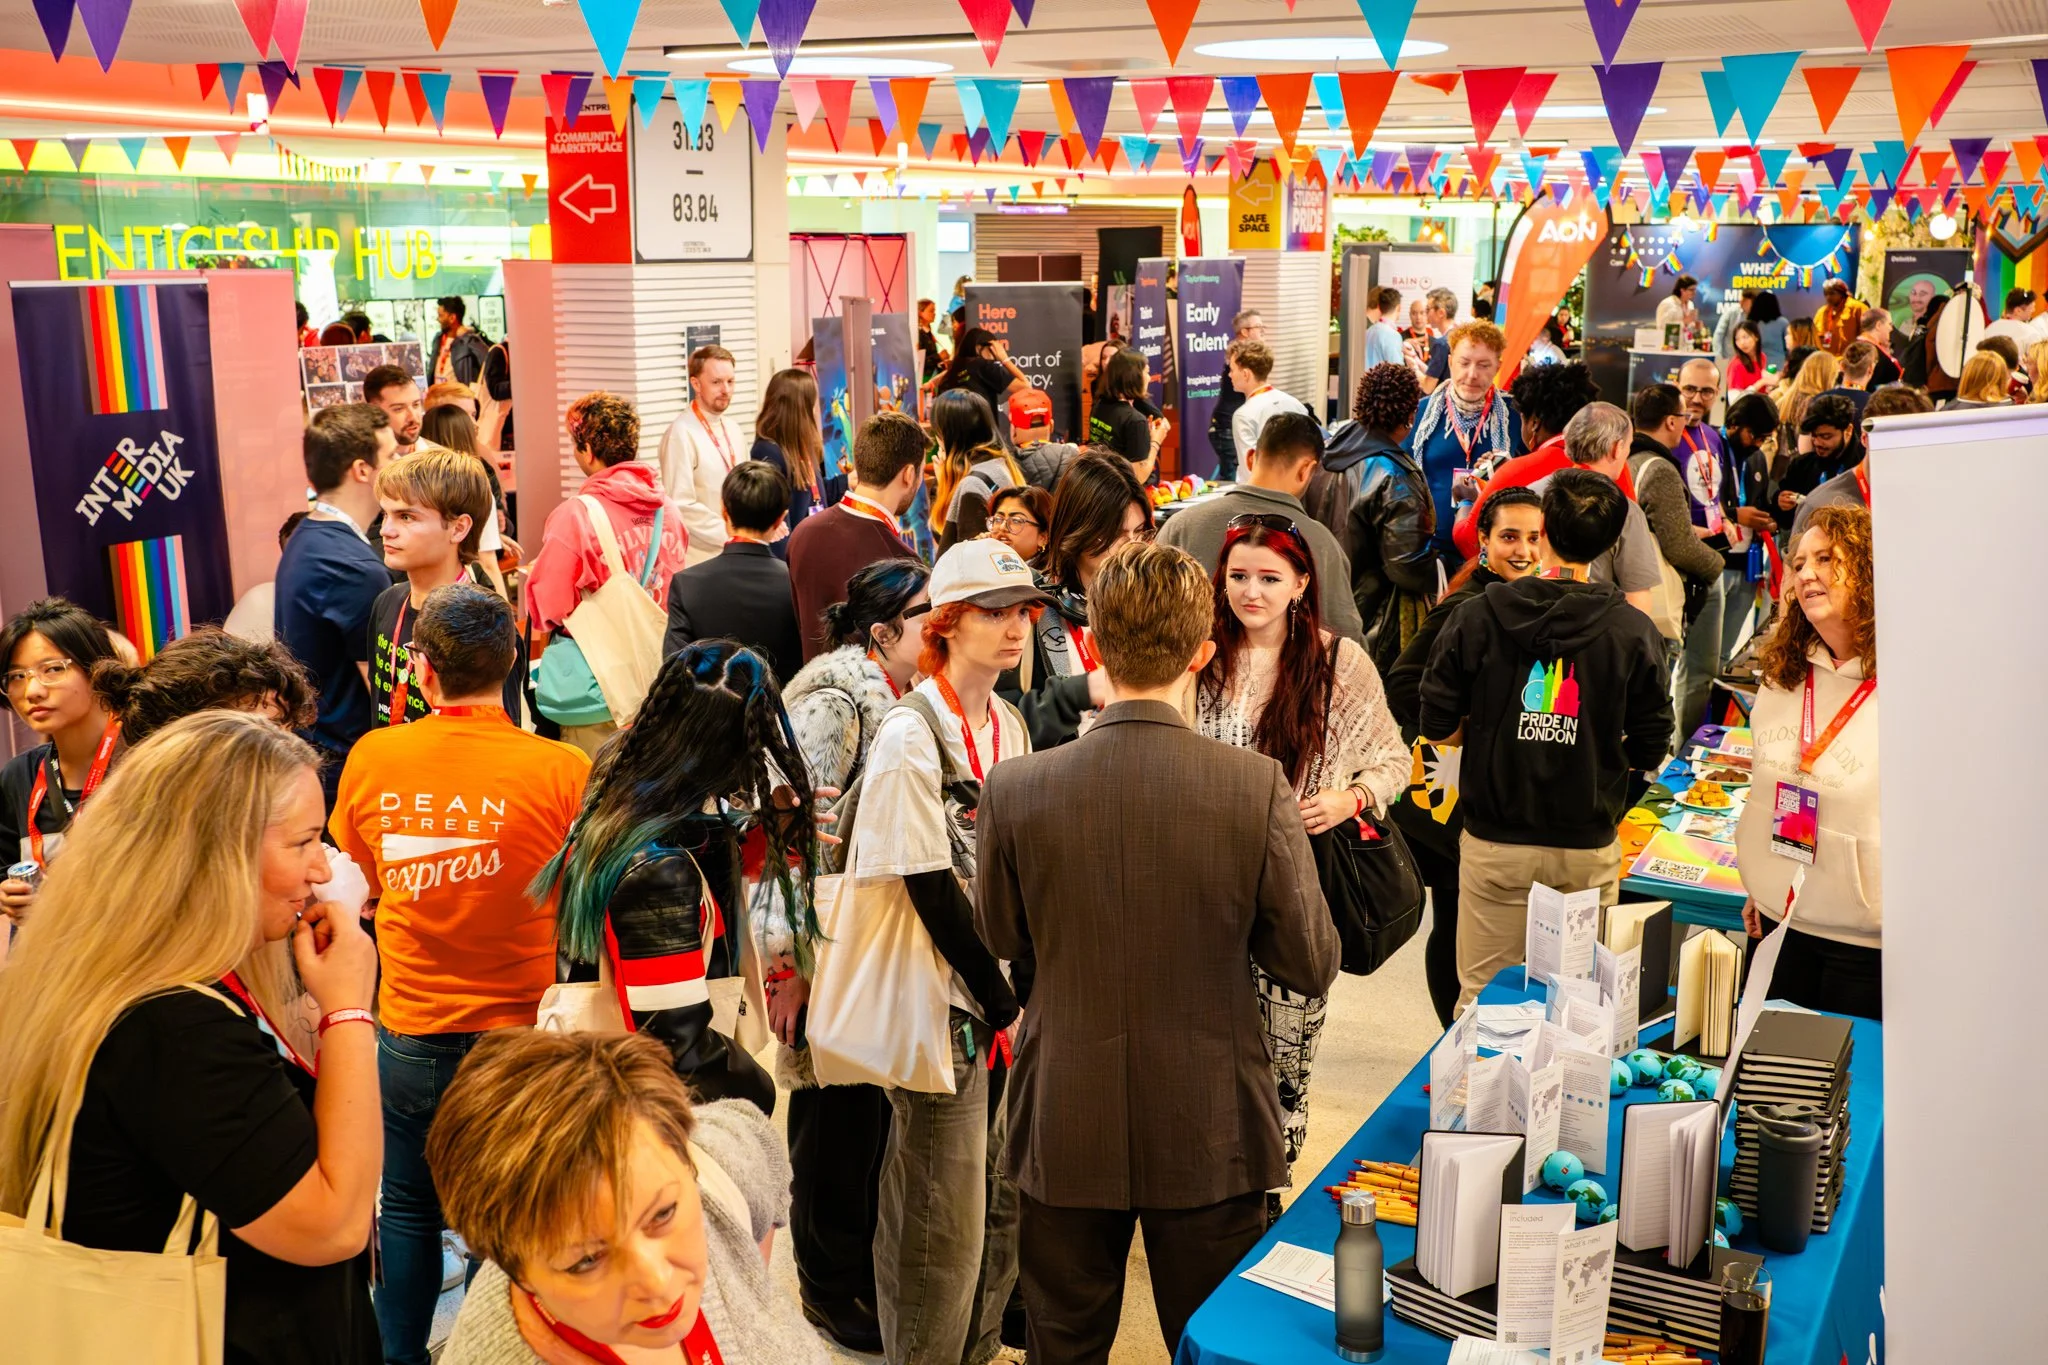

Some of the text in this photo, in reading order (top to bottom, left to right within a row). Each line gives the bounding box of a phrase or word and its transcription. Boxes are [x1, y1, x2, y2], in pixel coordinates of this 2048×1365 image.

[554, 131, 616, 144] COMMUNITY
[550, 142, 623, 154] MARKETPLACE
[673, 194, 718, 222] 03.04
[1242, 214, 1267, 223] SAFE
[1293, 207, 1323, 233] PRIDE
[1239, 224, 1270, 233] SPACE
[1537, 219, 1597, 243] AON
[355, 227, 438, 281] HUB
[1740, 262, 1795, 276] WHEE
[1732, 275, 1789, 289] BRIGHT
[978, 303, 1017, 319] Here
[1185, 302, 1220, 326] Early
[978, 321, 1008, 334] you
[1185, 332, 1230, 352] Talent
[1045, 350, 1062, 367] of
[1026, 374, 1053, 389] acy.
[156, 456, 195, 501] UK
[1519, 712, 1579, 731] PRIDE IN
[1517, 726, 1577, 745] LONDON
[380, 793, 505, 816] DEAN
[381, 816, 505, 833] STREET
[385, 847, 505, 902] express
[1509, 1214, 1543, 1223] included
